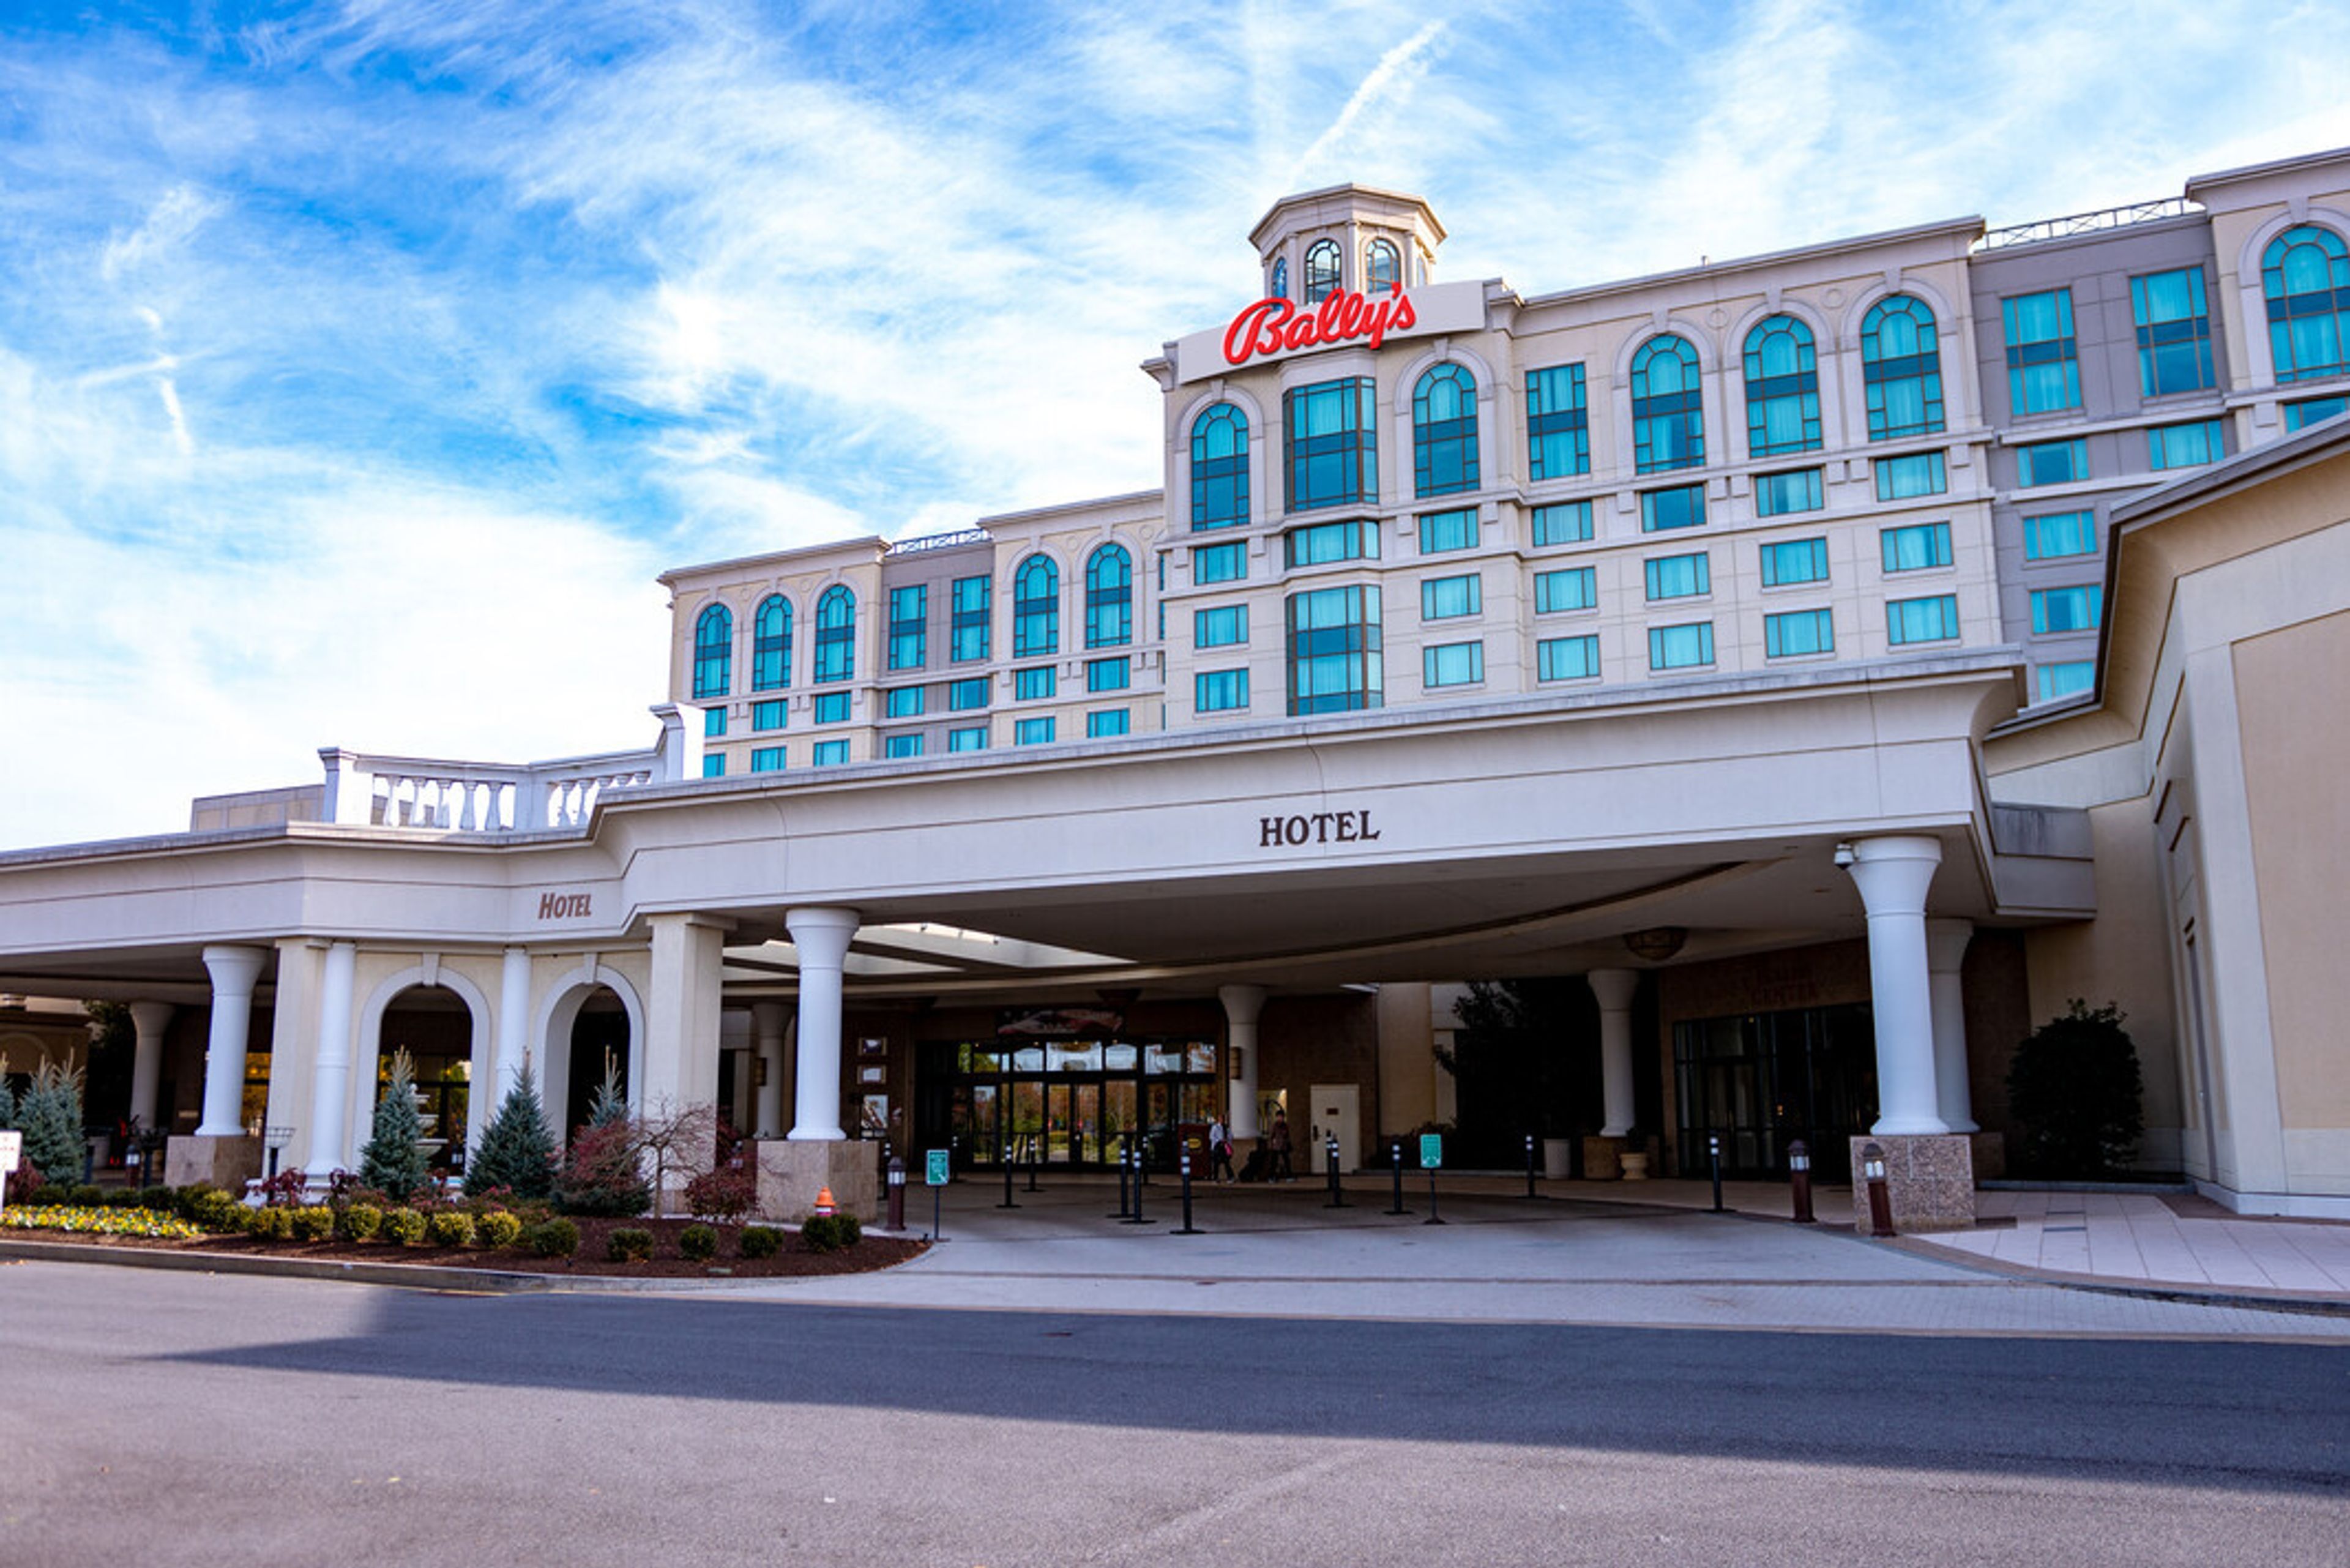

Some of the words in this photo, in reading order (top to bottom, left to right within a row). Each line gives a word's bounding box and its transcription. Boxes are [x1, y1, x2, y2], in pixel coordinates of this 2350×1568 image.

[1223, 282, 1416, 364] Bally's
[1259, 810, 1381, 846] HOTEL
[538, 892, 592, 919] HOTEL
